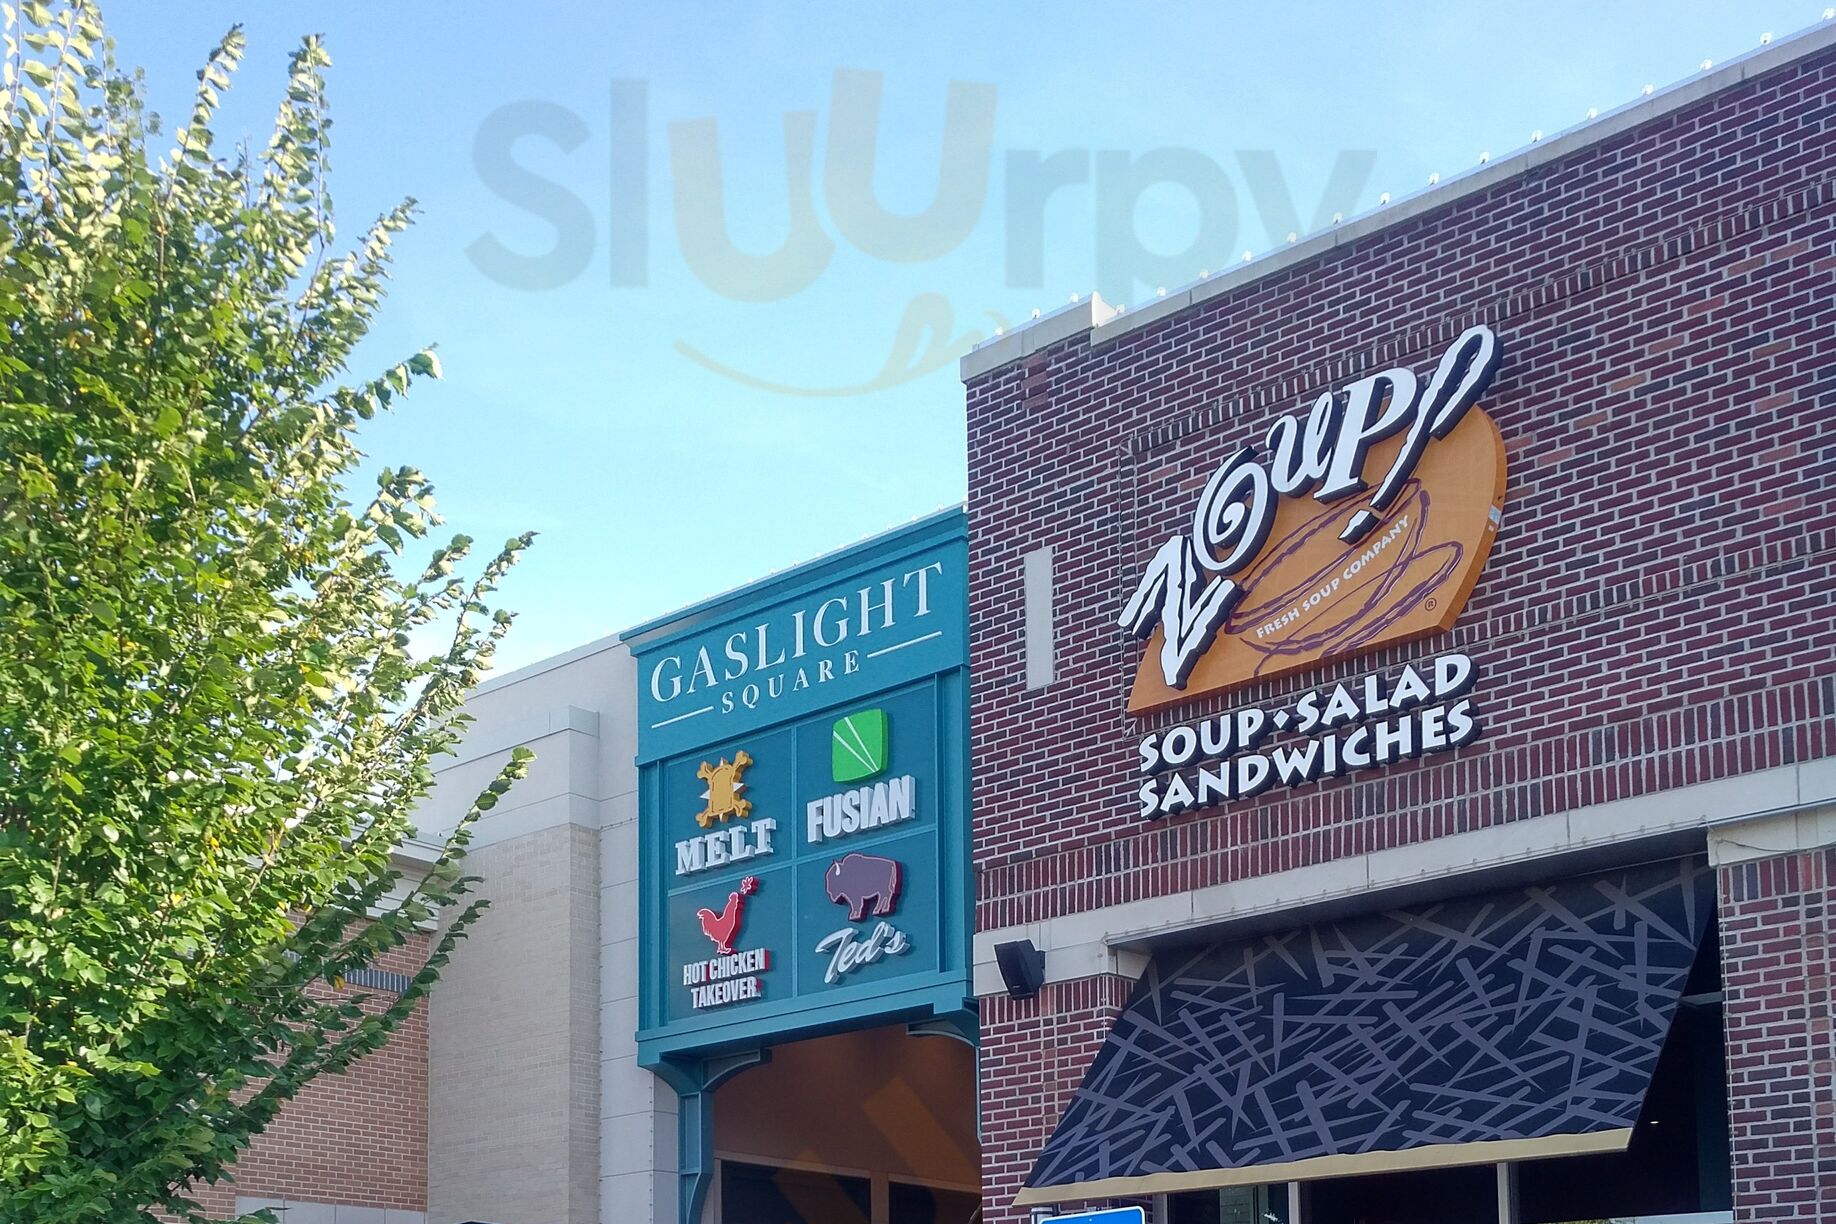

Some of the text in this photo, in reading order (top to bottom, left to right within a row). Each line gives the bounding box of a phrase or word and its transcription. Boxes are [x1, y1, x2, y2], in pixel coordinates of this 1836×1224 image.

[1256, 514, 1409, 639] FRESH SOUP COMPANY
[650, 560, 944, 703] GASLIGHT
[721, 650, 860, 715] SQUARE
[1140, 699, 1476, 818] SANDWICHES
[807, 775, 915, 843] FUSIAN
[675, 817, 776, 876] MELT
[683, 947, 766, 985] HOT CHICKEN
[815, 920, 910, 984] Ted's
